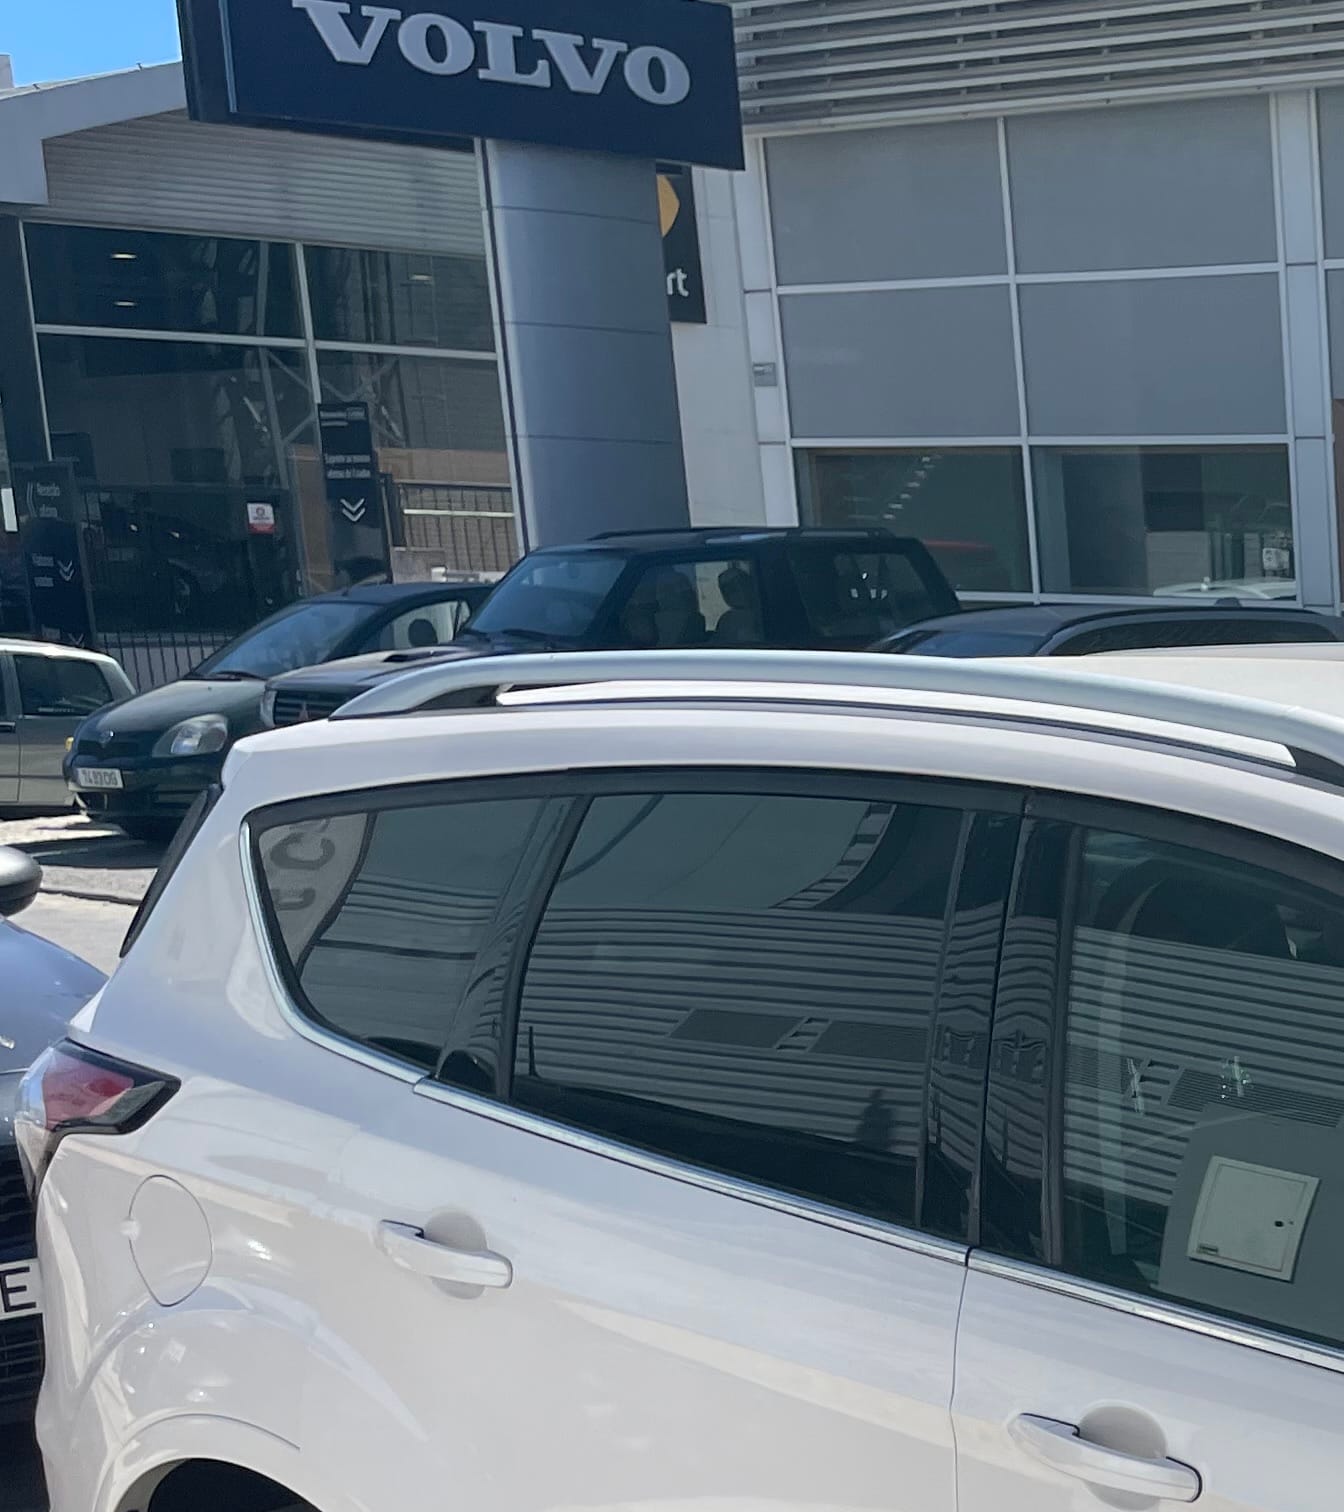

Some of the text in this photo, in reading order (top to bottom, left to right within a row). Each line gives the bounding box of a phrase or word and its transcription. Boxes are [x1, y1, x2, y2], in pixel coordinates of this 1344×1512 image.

[292, 0, 691, 105] VOLVO
[666, 268, 689, 297] rt
[0, 1266, 37, 1312] E
